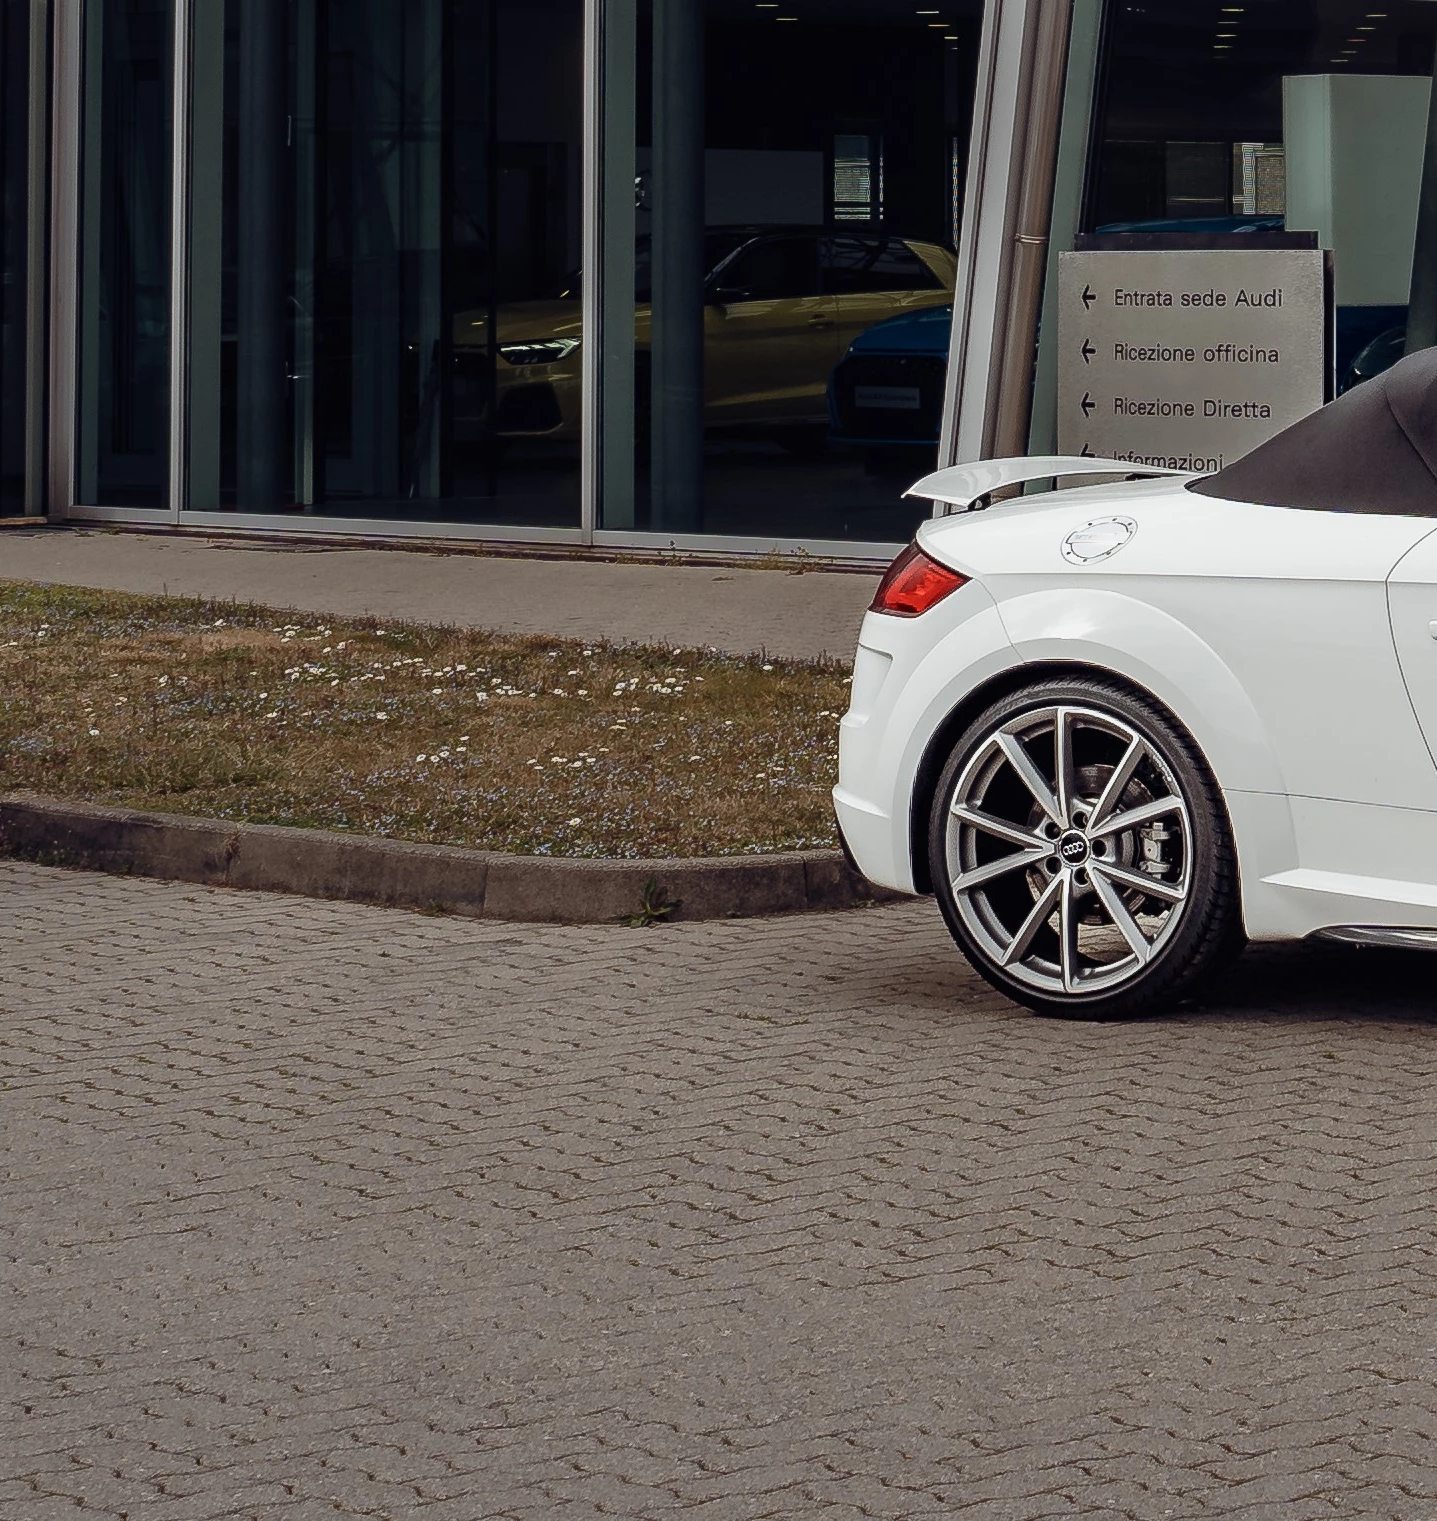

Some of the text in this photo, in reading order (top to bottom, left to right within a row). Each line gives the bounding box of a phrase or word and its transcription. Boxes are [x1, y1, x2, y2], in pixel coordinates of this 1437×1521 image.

[1114, 288, 1284, 308] Entrata sede Audi
[1114, 343, 1280, 363] Ricezione officina
[1114, 397, 1271, 419] Ricezione Diretta
